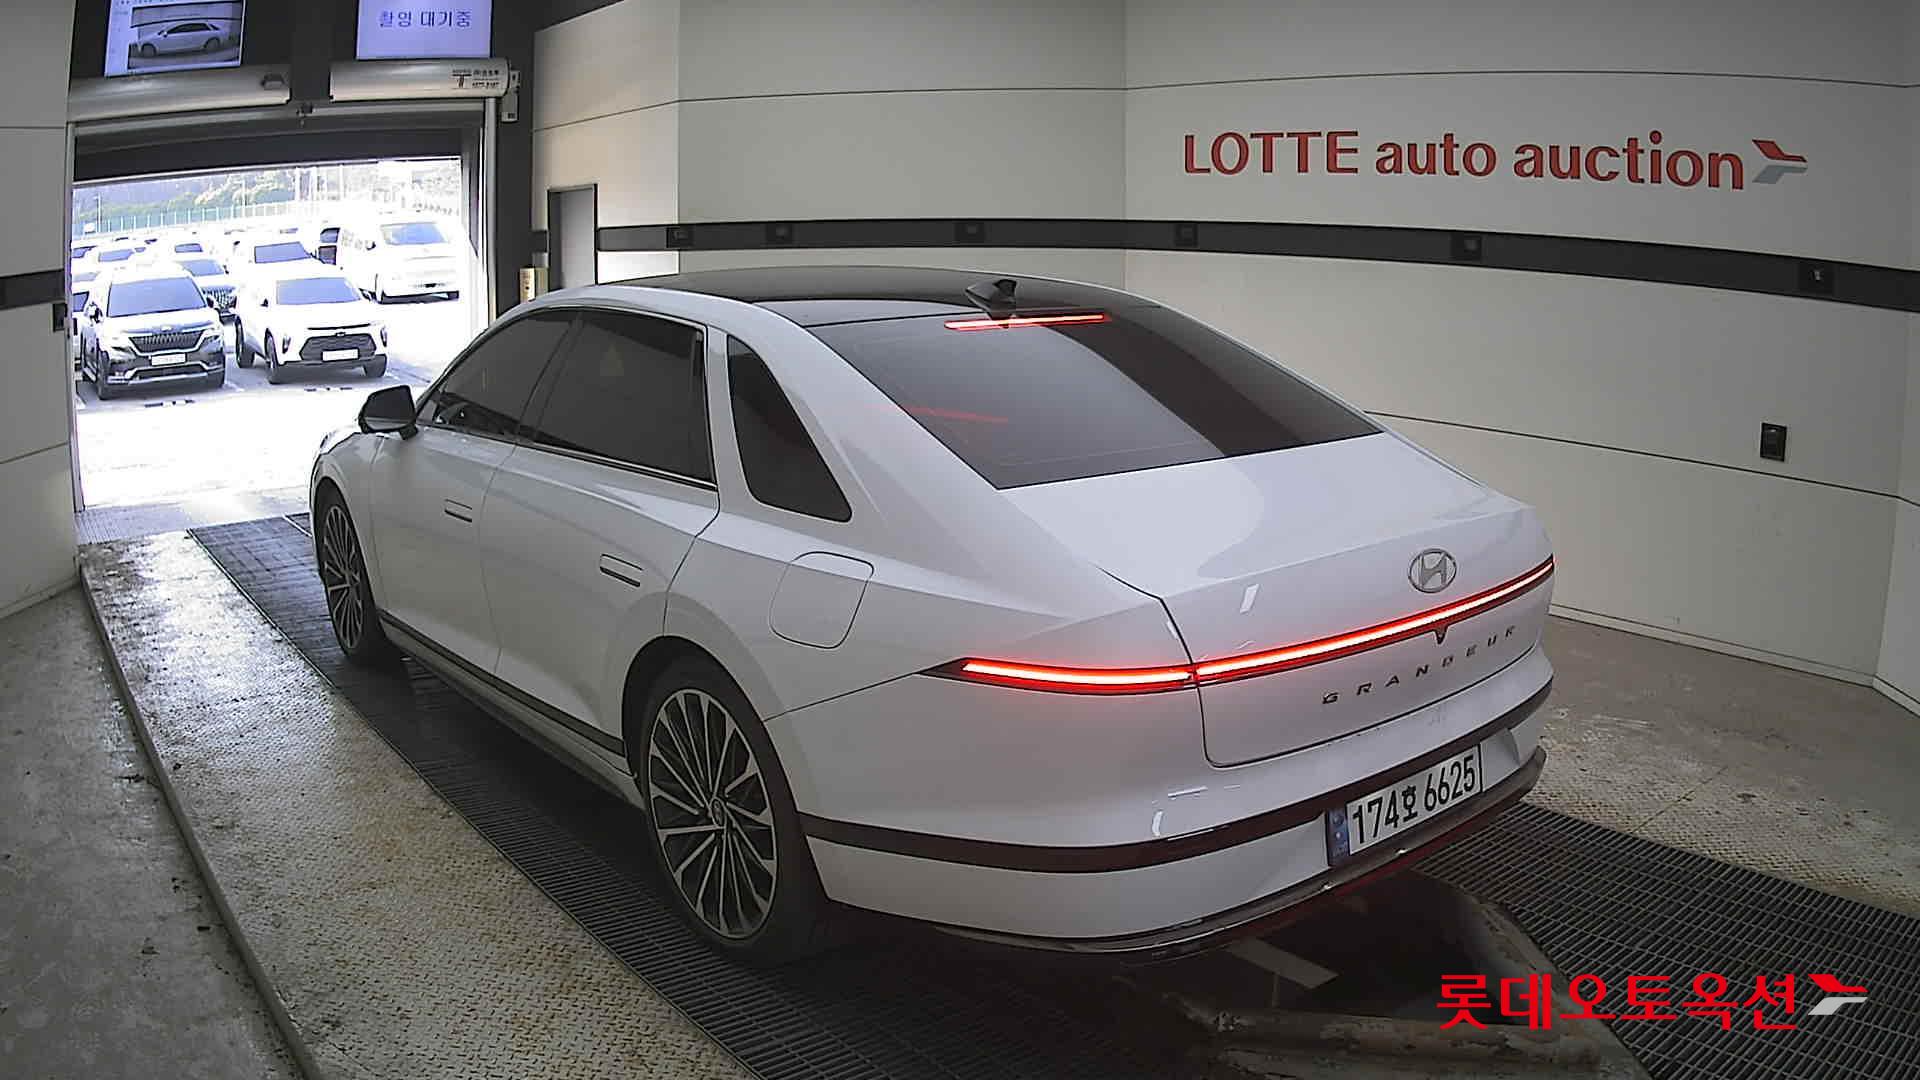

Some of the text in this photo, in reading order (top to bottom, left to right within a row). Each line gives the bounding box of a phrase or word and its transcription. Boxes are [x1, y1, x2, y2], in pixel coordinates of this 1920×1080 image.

[420, 11, 471, 27] 대기중
[1184, 130, 1745, 189] LOTTE auto auction
[1322, 625, 1515, 704] GRANDEUR
[1424, 754, 1476, 812] 6625
